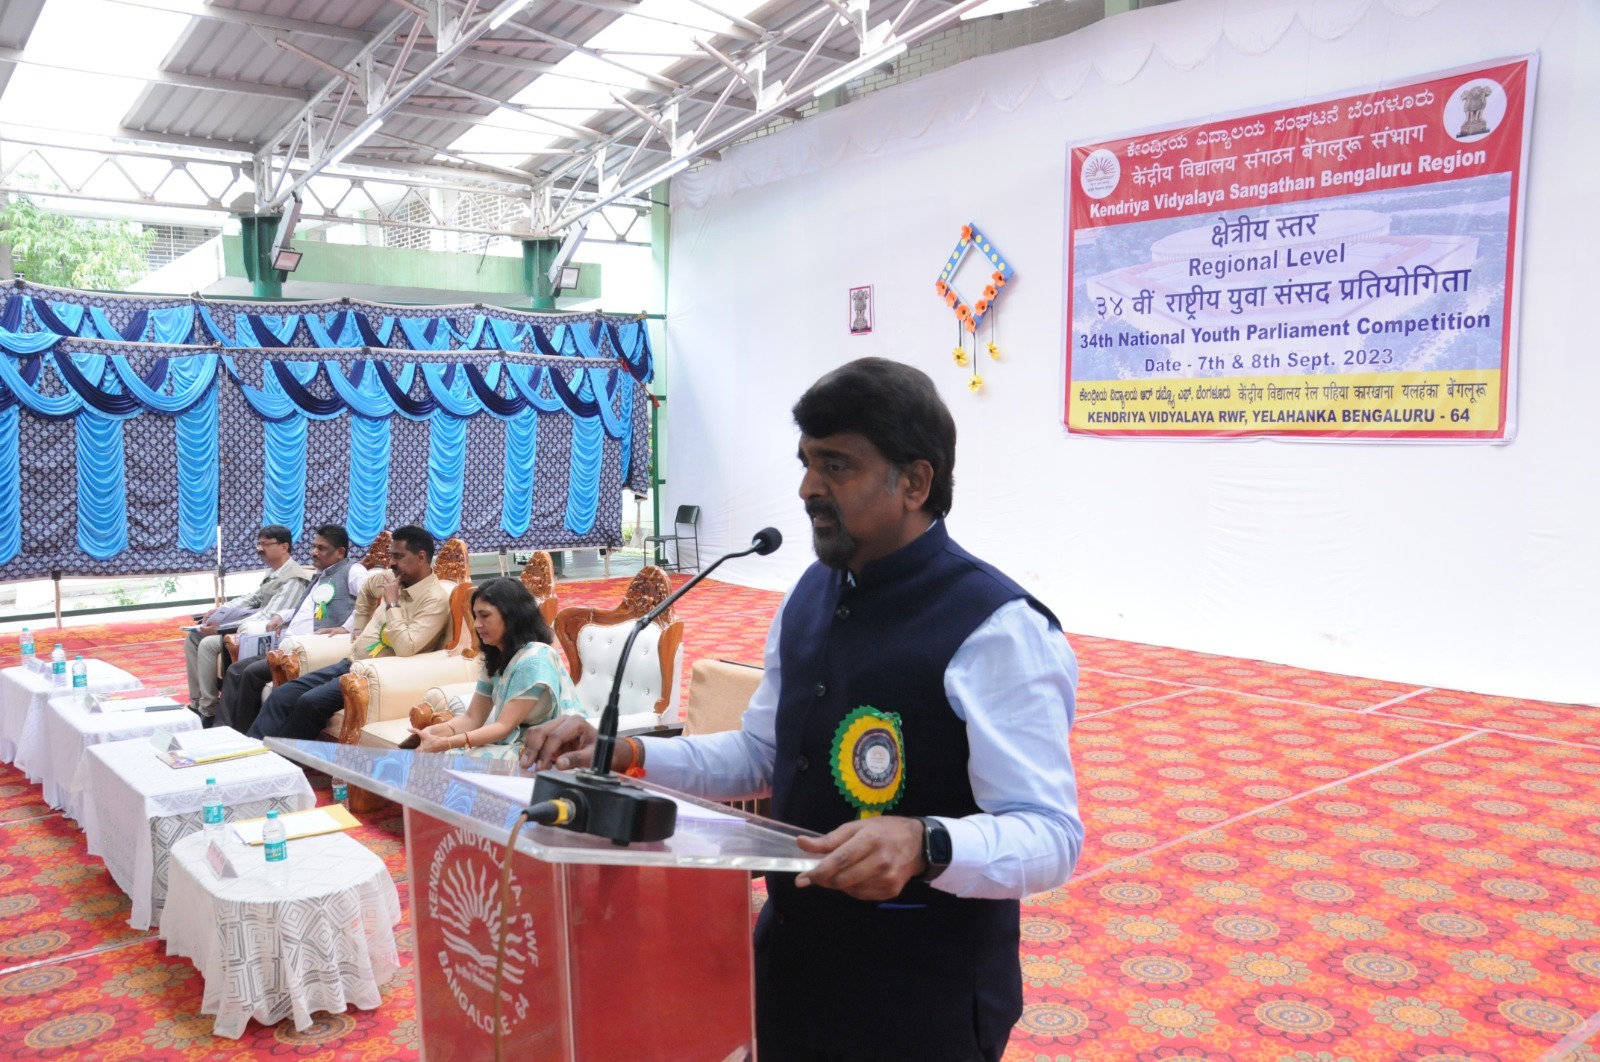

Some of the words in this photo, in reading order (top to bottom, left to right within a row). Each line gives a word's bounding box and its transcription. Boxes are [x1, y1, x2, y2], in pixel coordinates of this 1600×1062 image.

[1196, 120, 1265, 150] ವಿದ್ಯಾಲಯ
[1348, 88, 1435, 120] ಬೆಂಗಳೂರು
[1179, 156, 1238, 180] विद्यालय
[1244, 146, 1295, 170] संगठन
[1370, 124, 1428, 149] संभाग
[1090, 198, 1150, 218] Kendriya
[1153, 188, 1224, 211] Vidyalaya
[1230, 175, 1315, 200] Sangathan
[1320, 162, 1412, 187] Bengaluru
[1418, 150, 1486, 173] Region
[1212, 214, 1270, 248] क्षेत्रीय
[1276, 214, 1320, 238] स्तर
[1189, 250, 1278, 279] Regional
[1286, 243, 1344, 268] Level
[1096, 296, 1123, 319] ३४
[1132, 289, 1155, 314] वीं
[1166, 284, 1221, 320] राष्ट्रीय
[1227, 286, 1267, 314] युवा
[1274, 278, 1332, 305] संसद
[1339, 264, 1472, 301] प्रतियोगिता
[1080, 333, 1113, 348] 34th
[1118, 329, 1184, 346] National
[1192, 326, 1240, 343] Youth
[1246, 319, 1349, 340] Parliament
[1357, 312, 1490, 336] Competition
[1145, 358, 1182, 372] Date
[1198, 356, 1224, 370] 7th
[1232, 355, 1244, 369] &
[1251, 354, 1280, 368] 8th
[1288, 352, 1335, 370] Sept.
[1344, 348, 1394, 366] 2023
[1268, 383, 1302, 400] विद्यालय
[1305, 382, 1318, 400] रेल
[1323, 382, 1349, 400] पहिया
[1353, 384, 1394, 400] कारखाना
[1402, 381, 1440, 400] यलहंका
[1088, 412, 1146, 423] KENDRIYA
[1149, 411, 1215, 422] VIDYALAYA
[1219, 410, 1248, 425] RWF,
[1252, 410, 1337, 422] YELAHANKA
[1342, 409, 1435, 422] BENGALURU
[1450, 408, 1470, 422] 64
[428, 833, 456, 919] KENDRIYA
[521, 913, 538, 967] RWF
[438, 950, 518, 1036] BANGALOE.
